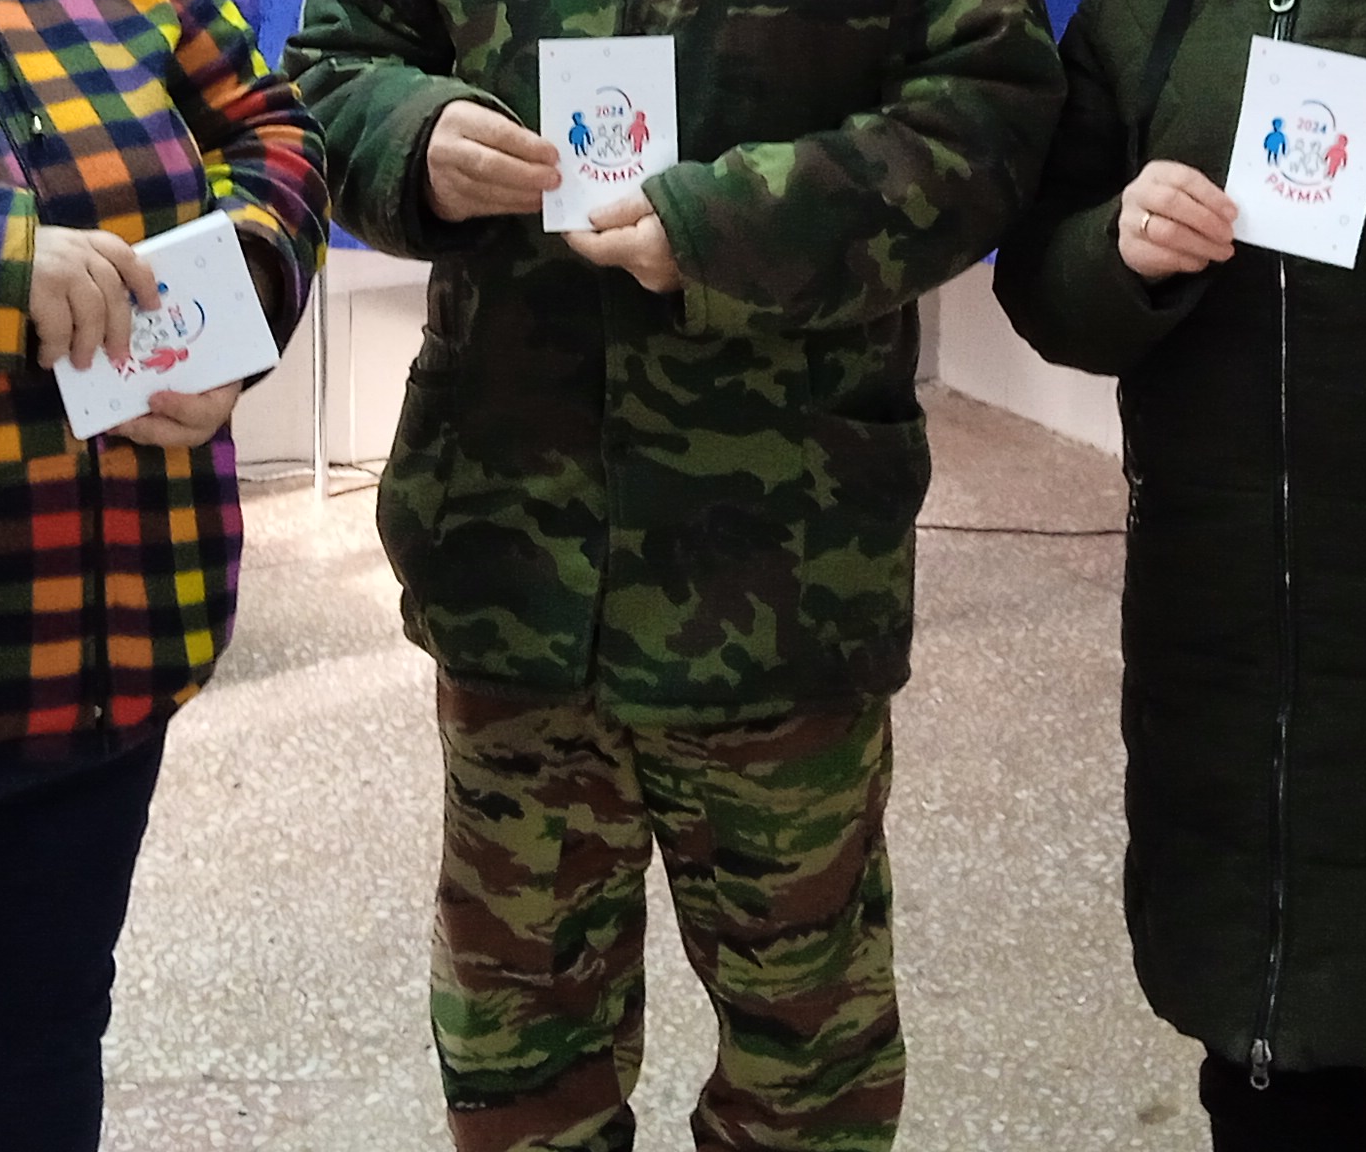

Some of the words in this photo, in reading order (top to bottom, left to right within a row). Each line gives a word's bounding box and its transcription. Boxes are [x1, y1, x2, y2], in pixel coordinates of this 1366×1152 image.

[596, 105, 624, 119] 2024
[1297, 118, 1327, 134] 2024
[580, 161, 645, 183] РАХМАТ
[1266, 173, 1333, 203] РАХМАТ
